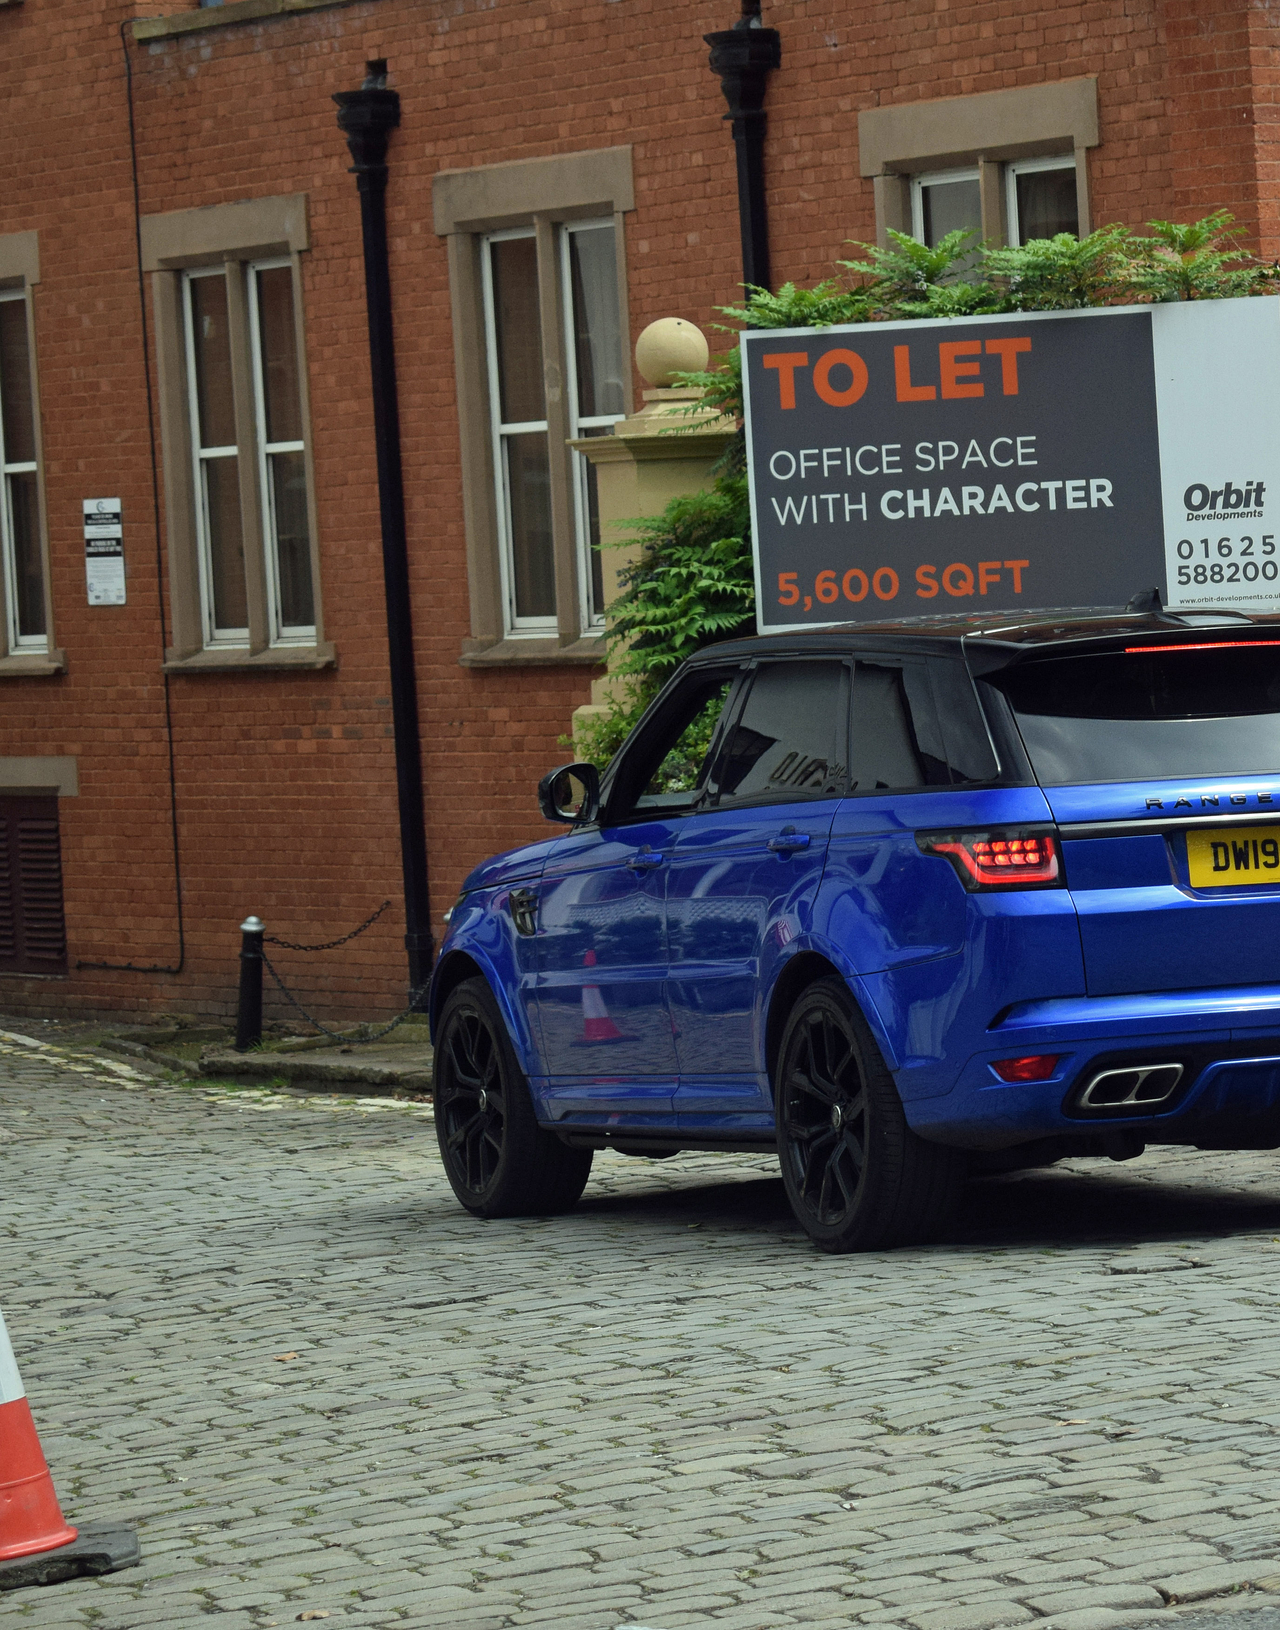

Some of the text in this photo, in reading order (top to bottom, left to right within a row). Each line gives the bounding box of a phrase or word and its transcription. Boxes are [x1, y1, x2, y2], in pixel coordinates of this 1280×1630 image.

[763, 337, 1032, 410] TO LET
[769, 435, 1038, 480] OFFICE SPACE
[771, 478, 1114, 526] WITH CHARACTER
[1183, 481, 1266, 512] Orbit
[1186, 509, 1264, 521] Developments
[1177, 535, 1276, 560] 01625
[778, 560, 1030, 611] 5,600 SQFT
[1177, 560, 1279, 586] 588200
[1145, 791, 1274, 810] RANGE
[1210, 838, 1280, 872] DW19
